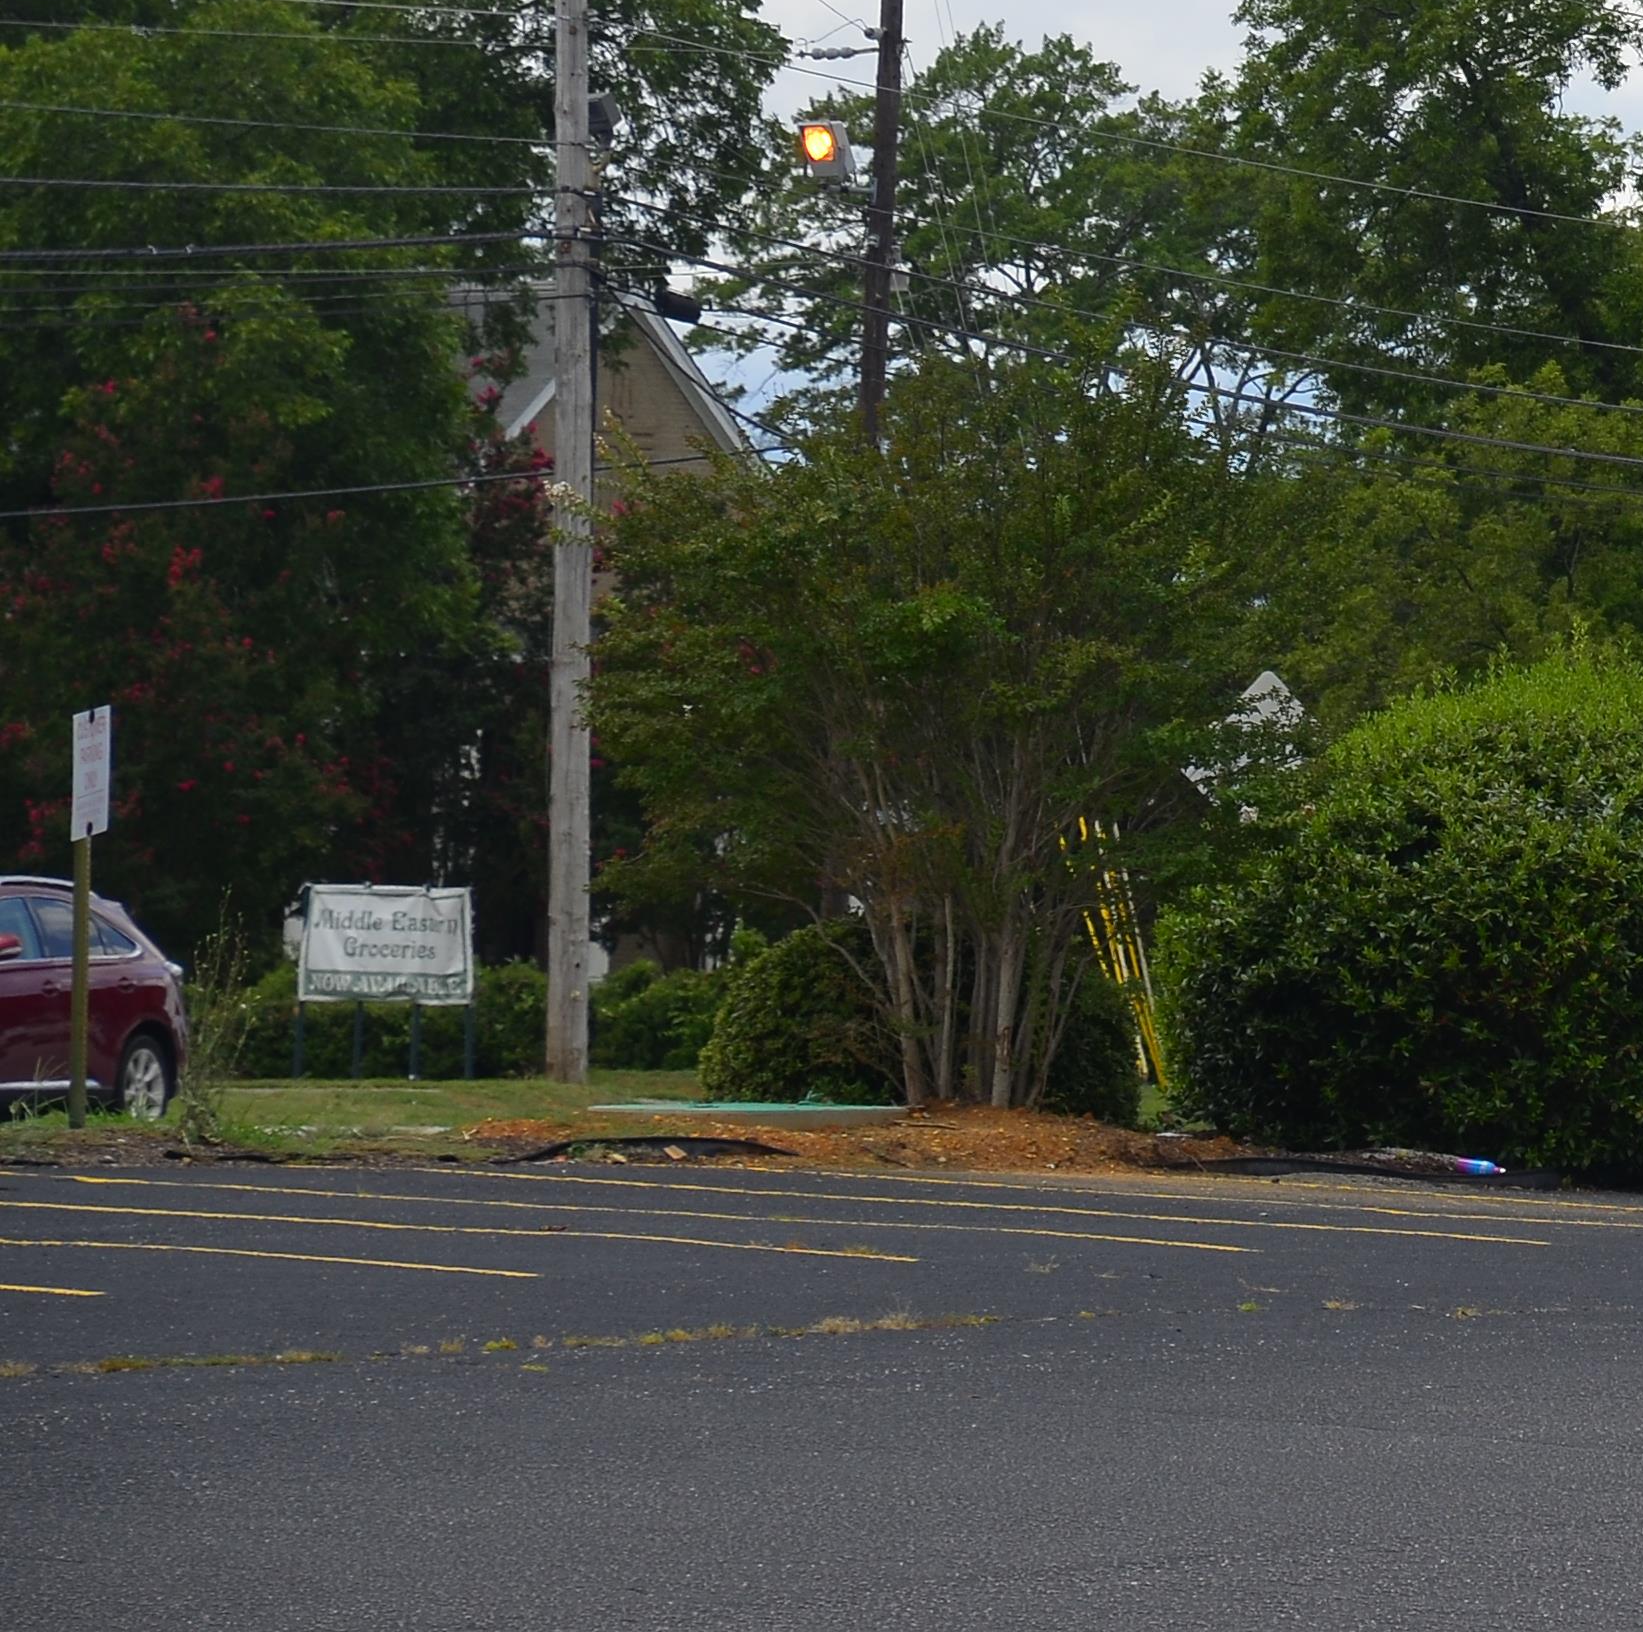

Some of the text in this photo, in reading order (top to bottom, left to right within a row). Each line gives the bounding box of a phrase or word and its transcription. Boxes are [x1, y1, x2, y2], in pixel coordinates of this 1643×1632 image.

[314, 908, 383, 931] Middle
[343, 936, 436, 960] Groceries
[310, 973, 350, 991] NOW
